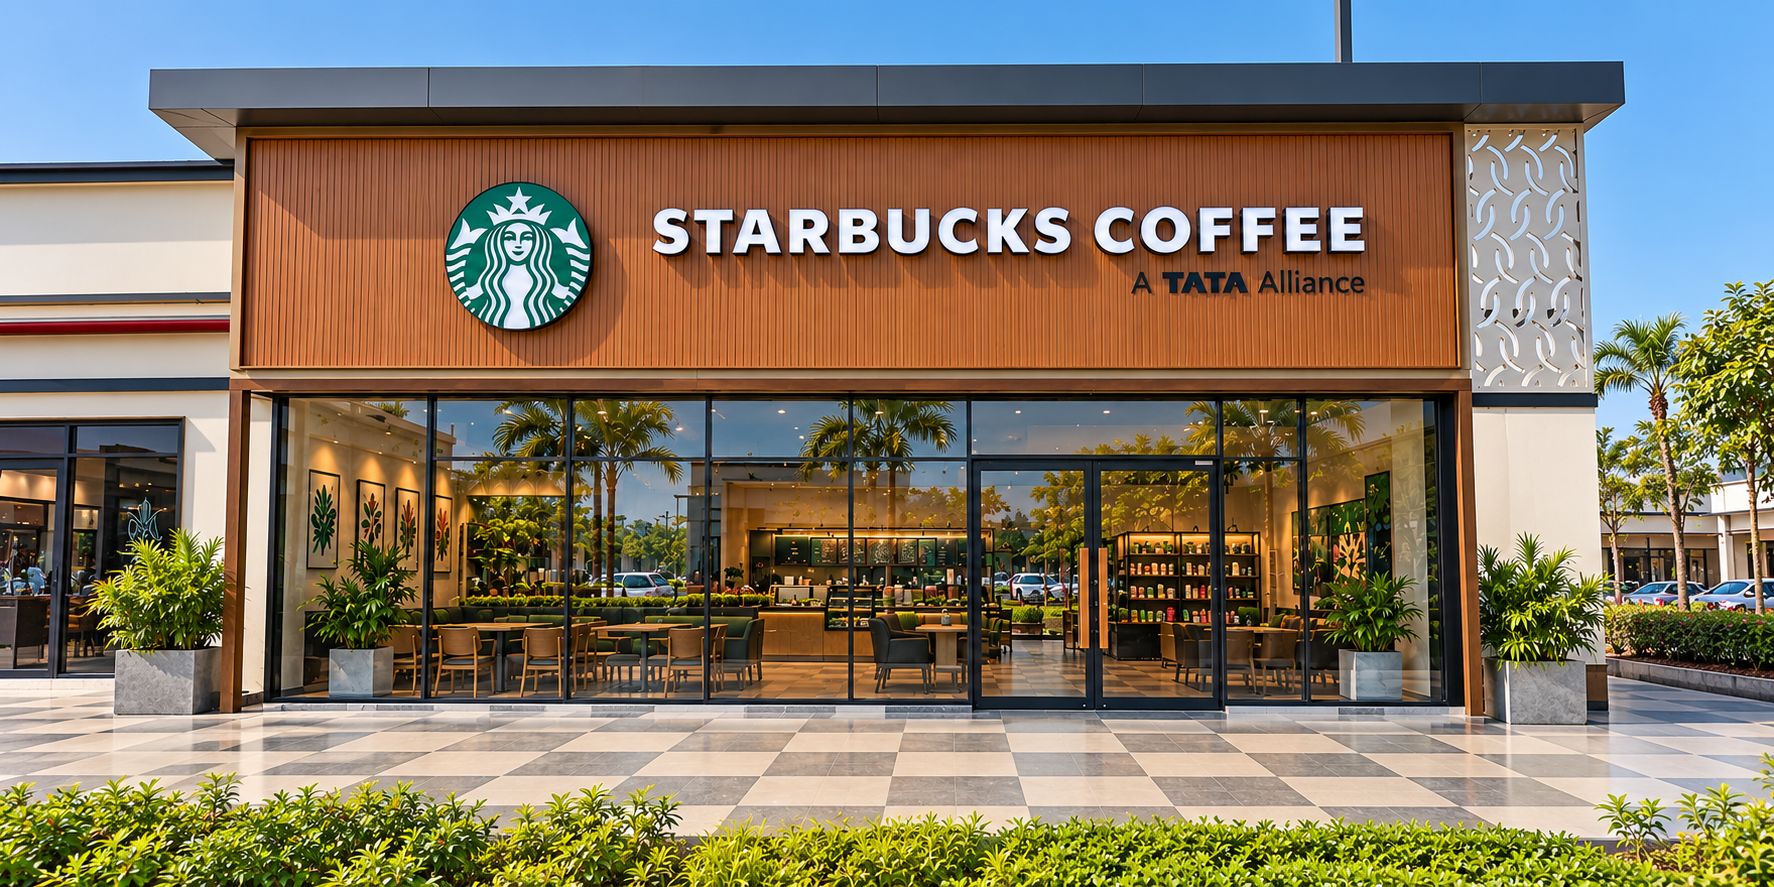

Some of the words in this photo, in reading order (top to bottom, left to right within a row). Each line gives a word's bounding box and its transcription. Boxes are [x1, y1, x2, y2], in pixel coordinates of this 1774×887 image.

[652, 207, 1072, 255] STARBUCKS
[1094, 206, 1366, 254] COFFEE
[1131, 271, 1153, 294] A
[1162, 271, 1249, 294] TATA
[1257, 269, 1366, 295] Alliance
